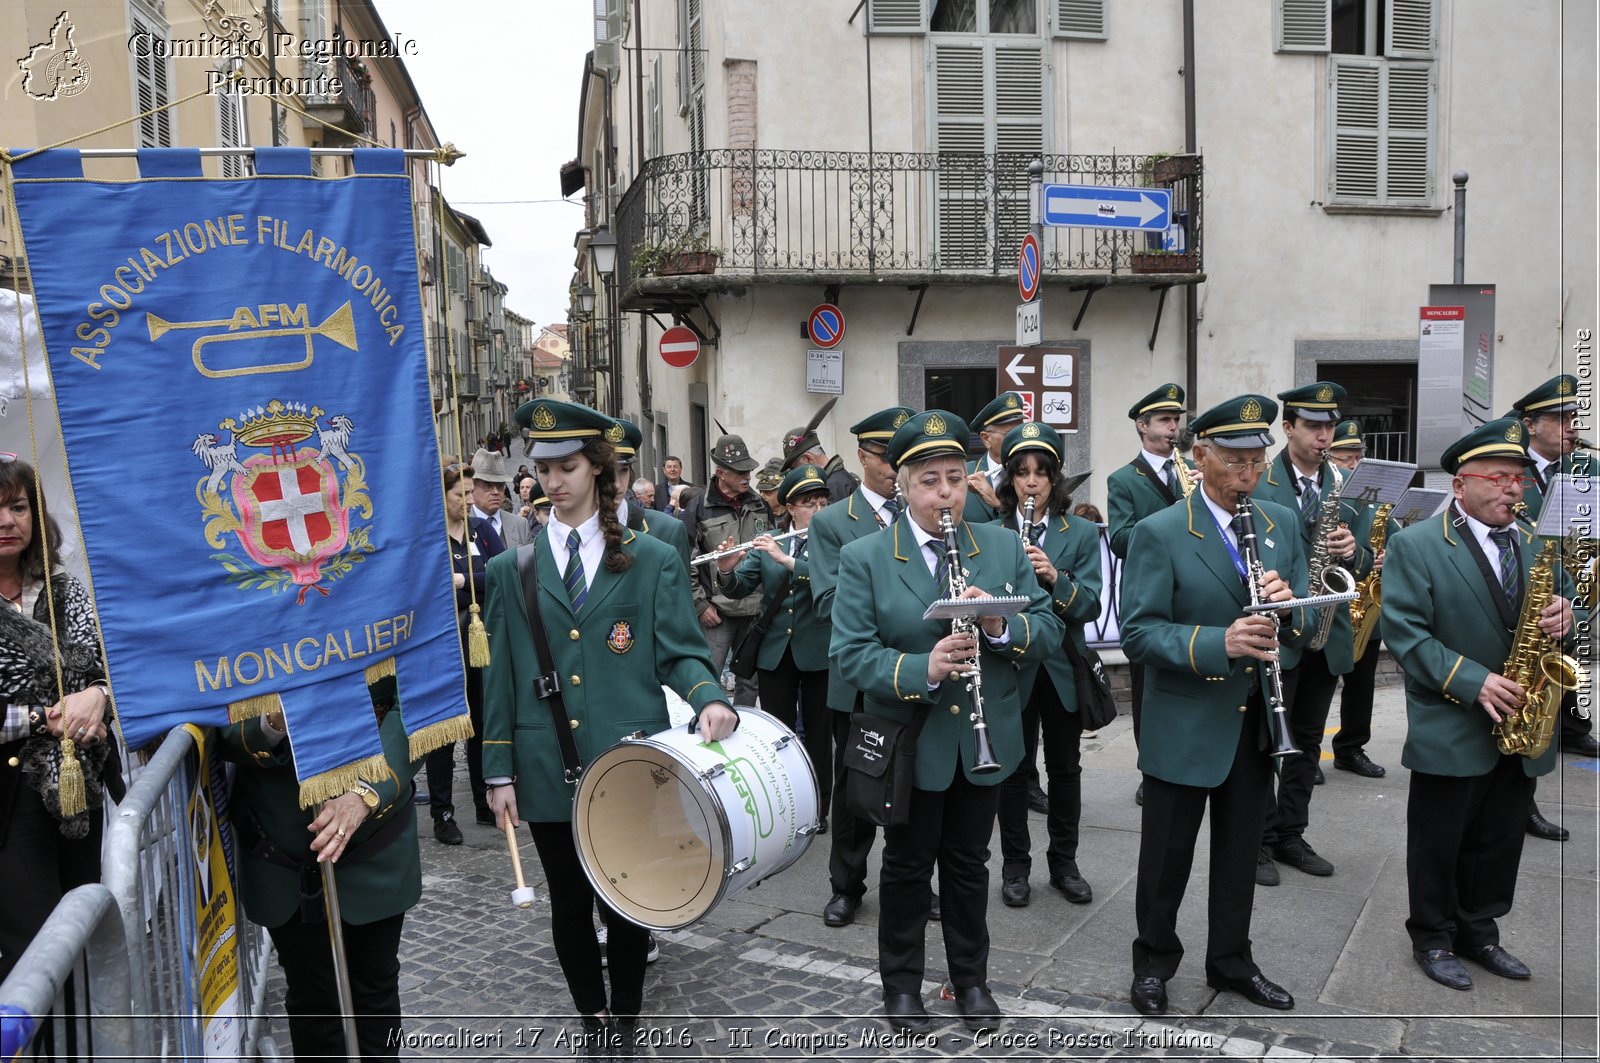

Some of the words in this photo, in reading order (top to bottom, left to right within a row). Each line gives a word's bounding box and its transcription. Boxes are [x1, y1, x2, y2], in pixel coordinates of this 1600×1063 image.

[70, 213, 249, 370] ASSOCIAZIONE
[257, 215, 405, 347] FILARMONICA
[229, 302, 308, 330] AFM
[1023, 314, 1039, 334] 0-24
[194, 610, 415, 693] MONCALIERI
[723, 764, 757, 817] AFM
[745, 743, 786, 823] Associazione
[780, 774, 797, 855] Filarmonica
